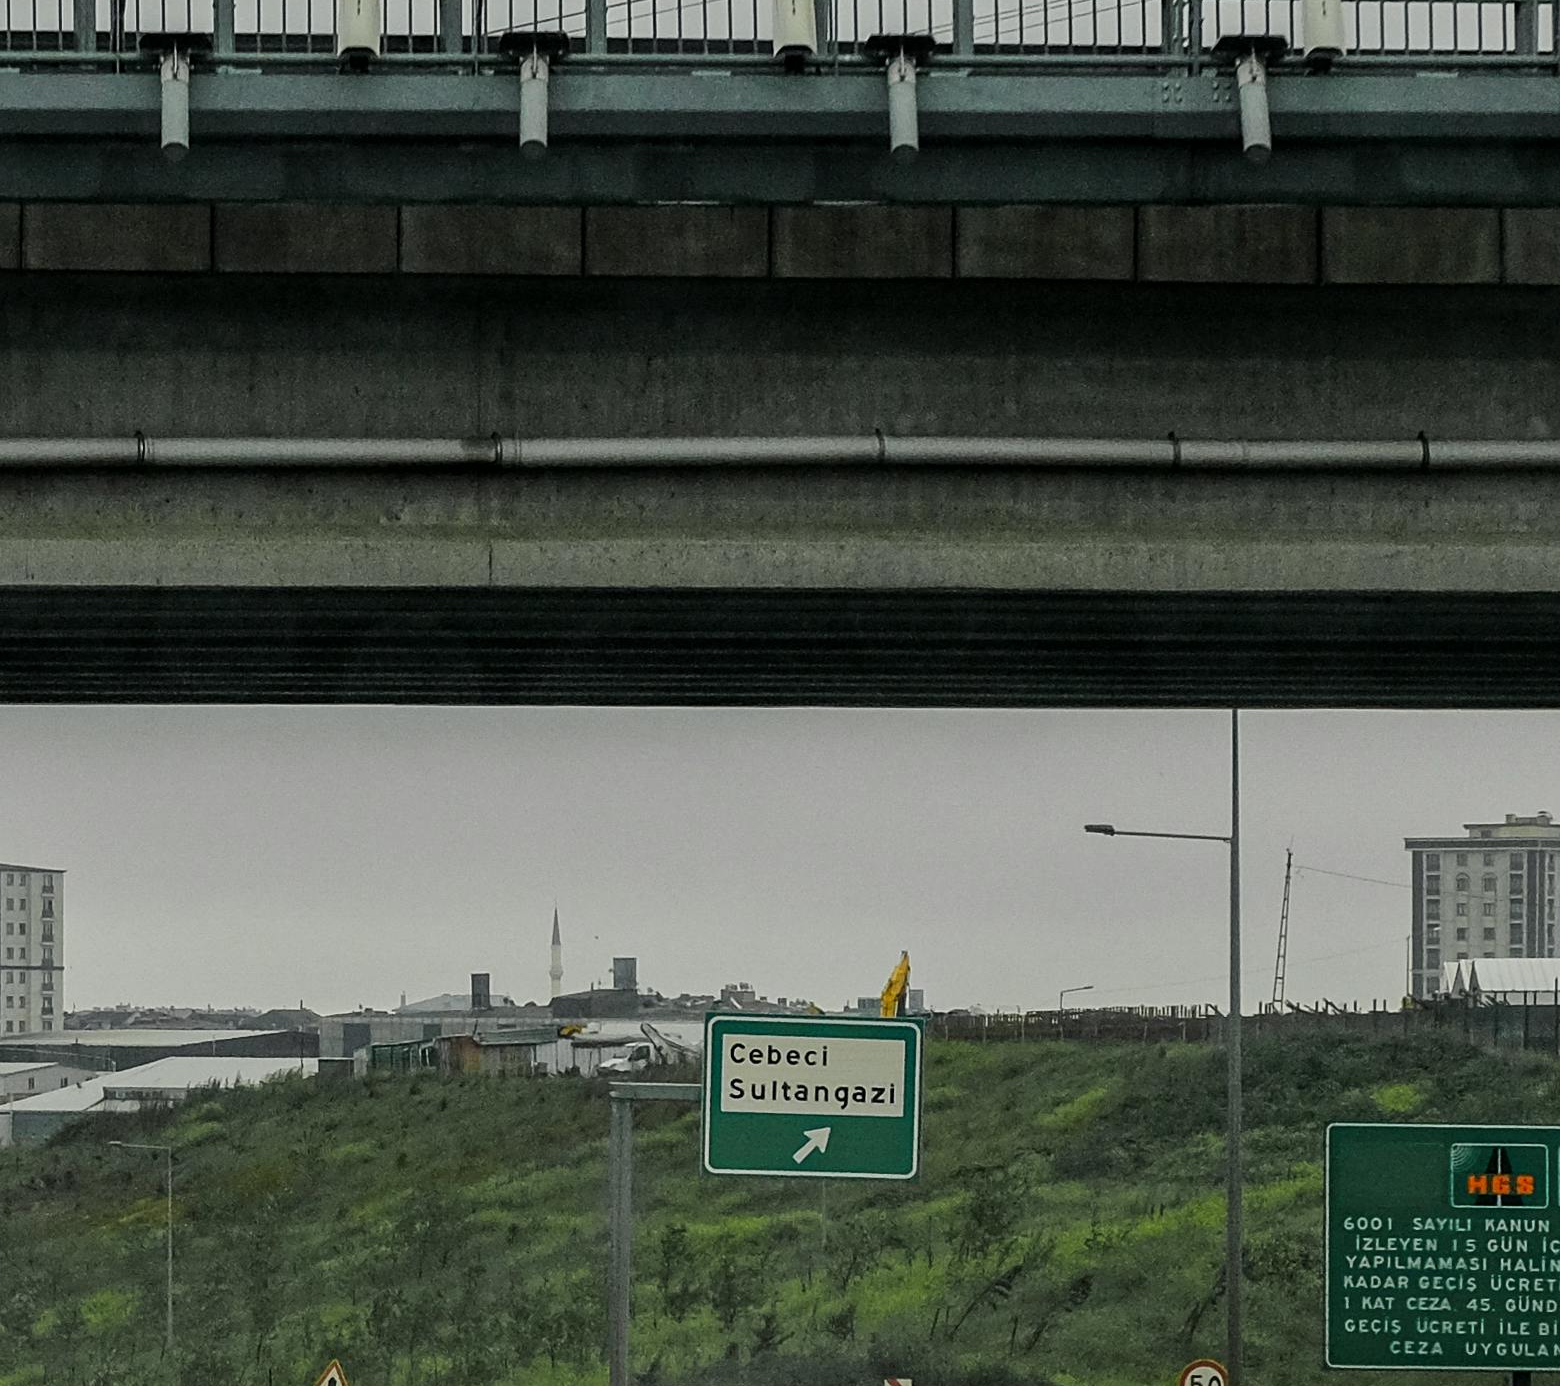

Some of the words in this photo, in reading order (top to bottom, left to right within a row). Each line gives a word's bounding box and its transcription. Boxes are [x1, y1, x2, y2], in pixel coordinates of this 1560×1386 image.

[730, 1043, 829, 1066] Cebeci
[729, 1078, 895, 1110] Sultangazi
[1468, 1175, 1533, 1194] HGS
[1344, 1217, 1391, 1230] 6001
[1413, 1218, 1471, 1231] SAYILI
[1486, 1220, 1549, 1232] KANUN
[1357, 1235, 1436, 1250] İZLEYEN
[1488, 1237, 1527, 1252] GÜN
[1346, 1256, 1486, 1270] YAPILMAMASI
[1344, 1276, 1408, 1288] KADAR
[1419, 1276, 1476, 1291] GEÇİŞ
[1345, 1297, 1349, 1309] 1
[1362, 1297, 1394, 1309] KAT
[1345, 1319, 1401, 1333] GEÇİŞ
[1417, 1319, 1484, 1334] ÜCRETİ
[1500, 1322, 1529, 1335] İLE
[1390, 1341, 1442, 1354] CEZA
